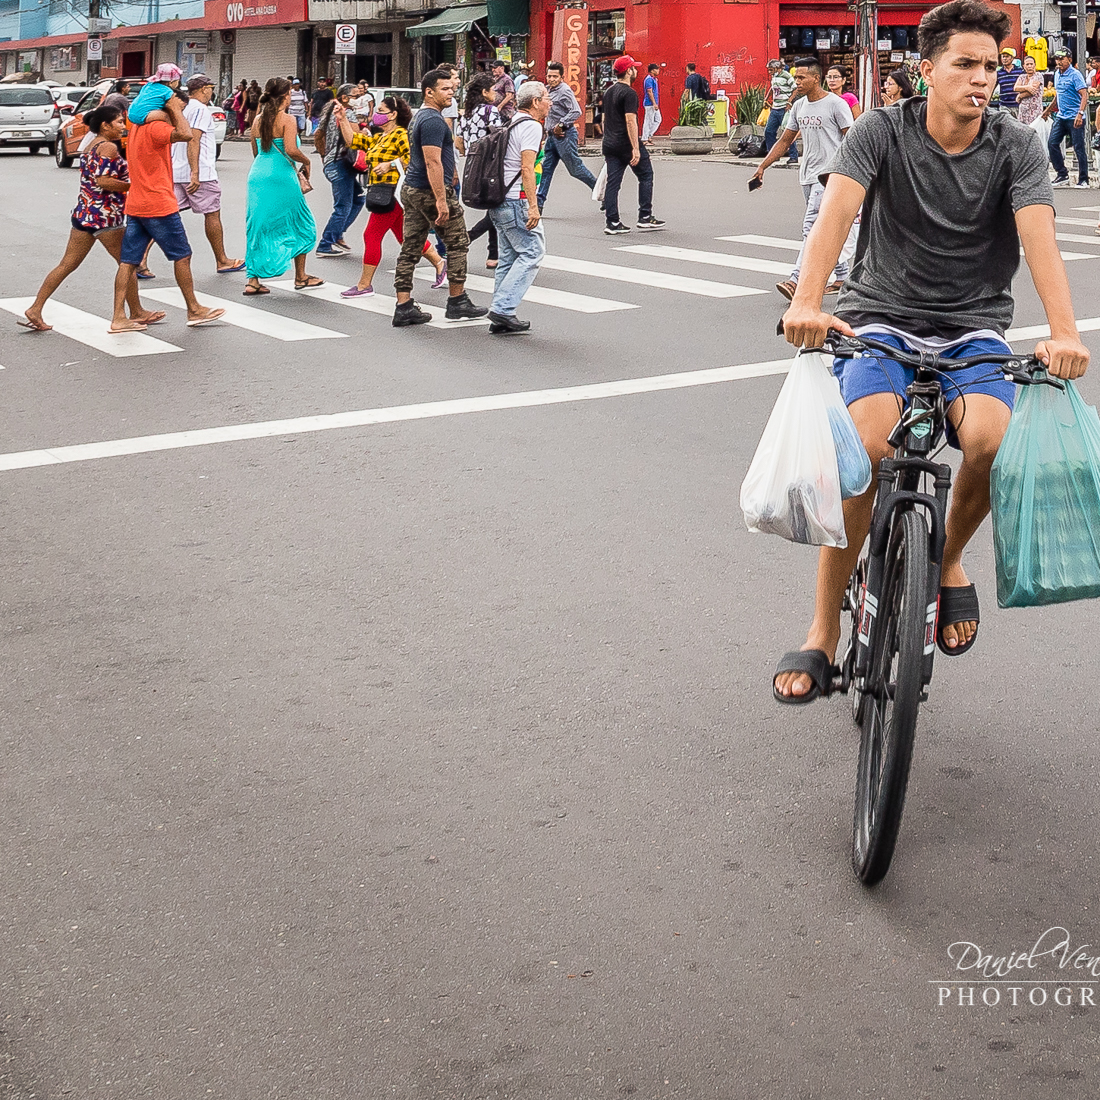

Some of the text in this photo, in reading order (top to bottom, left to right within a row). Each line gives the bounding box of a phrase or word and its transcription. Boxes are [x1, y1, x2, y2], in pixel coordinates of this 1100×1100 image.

[227, 2, 244, 22] OYO
[342, 28, 351, 39] E
[798, 116, 822, 126] BOSS
